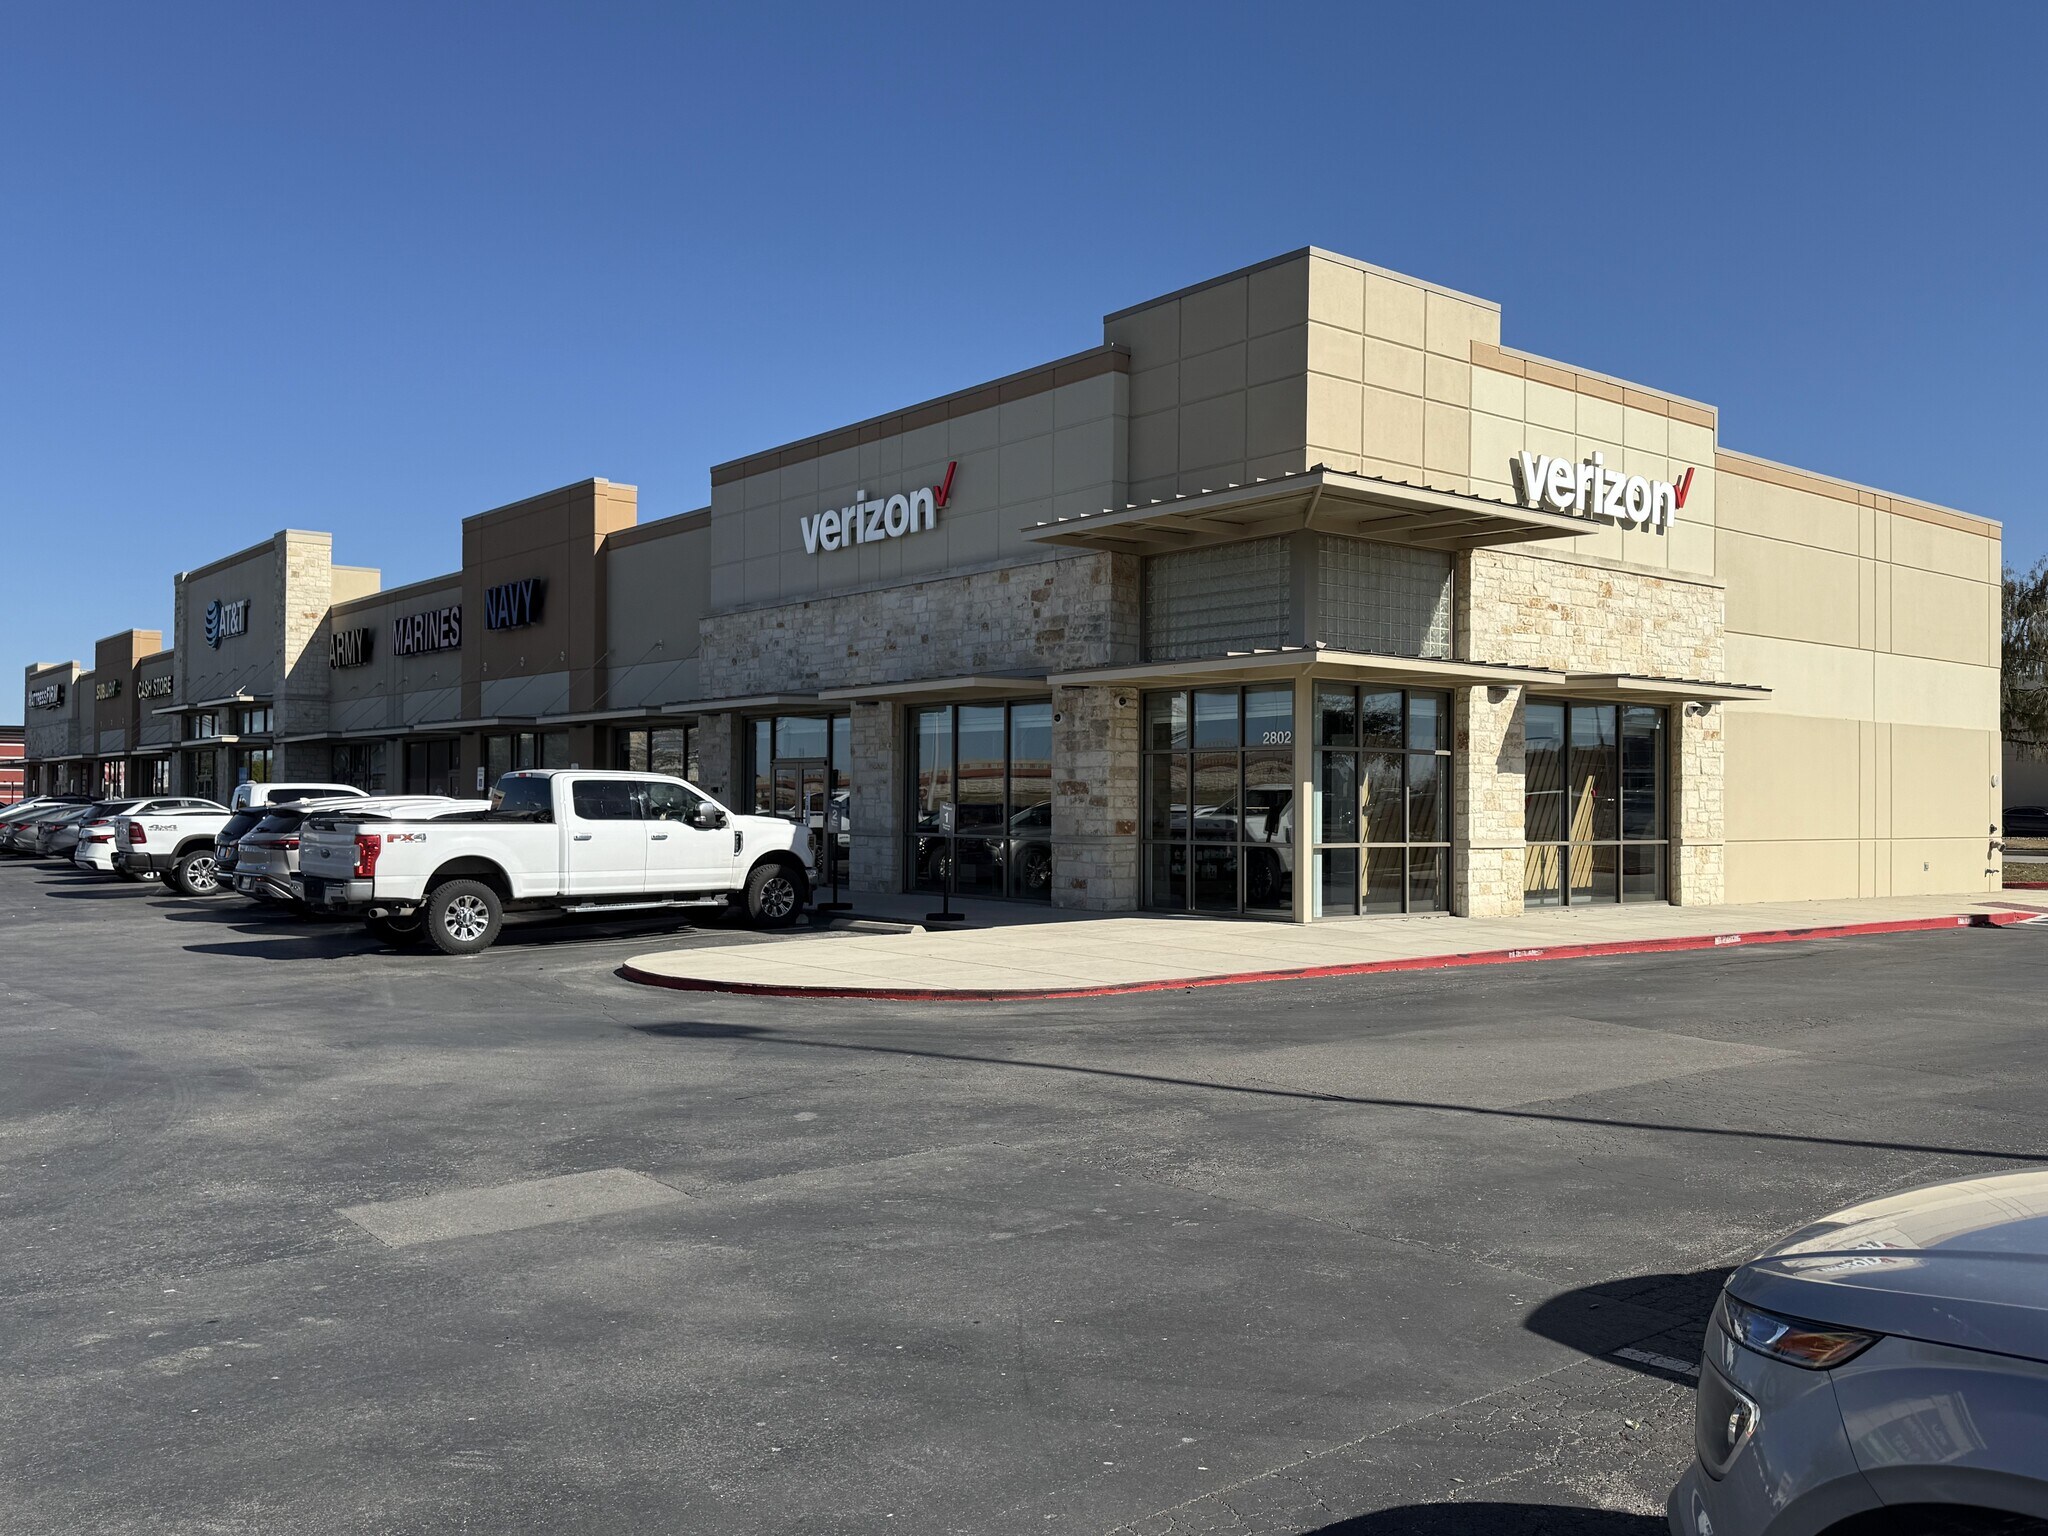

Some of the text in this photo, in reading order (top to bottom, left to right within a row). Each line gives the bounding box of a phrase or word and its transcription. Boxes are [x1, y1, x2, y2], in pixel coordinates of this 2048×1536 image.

[1518, 450, 1676, 528] verizon
[800, 487, 936, 554] verizon
[219, 600, 245, 637] AT&T
[485, 579, 533, 630] NAVY
[329, 628, 364, 667] ARMY
[392, 606, 460, 655] MARINES
[137, 676, 172, 699] CASH STORE
[1262, 731, 1292, 744] 2802
[832, 809, 838, 820] 2
[387, 833, 427, 842] FX4
